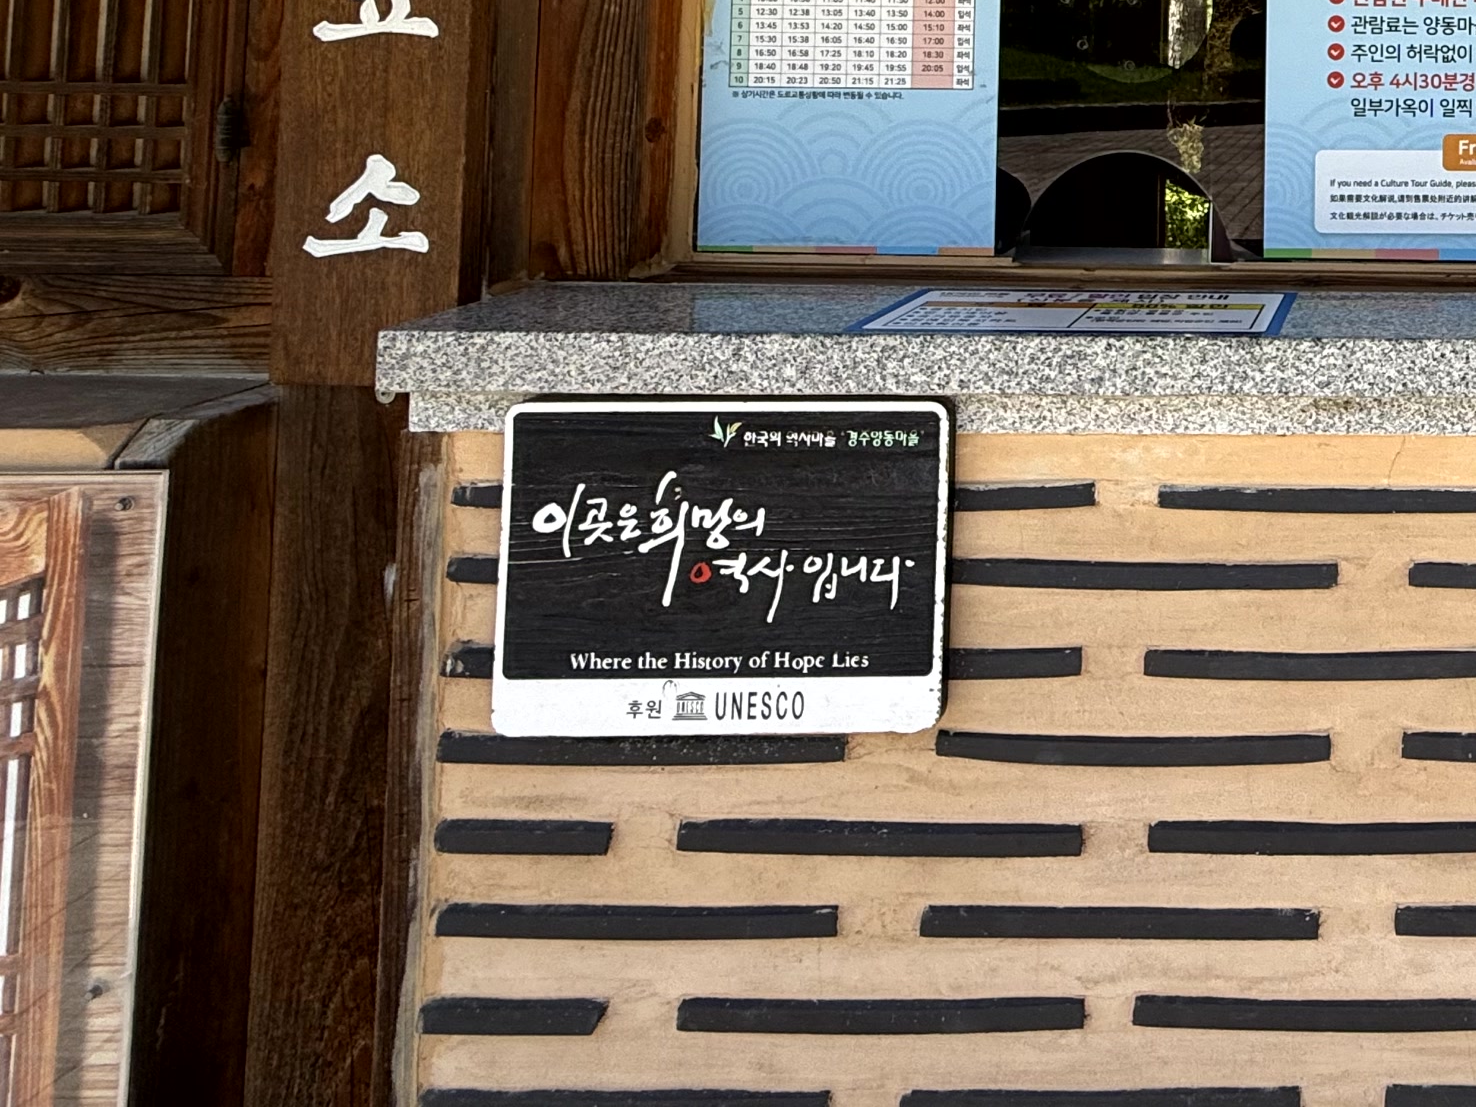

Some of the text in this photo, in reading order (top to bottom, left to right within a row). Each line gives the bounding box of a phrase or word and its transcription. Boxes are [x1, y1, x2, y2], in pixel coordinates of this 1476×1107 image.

[1329, 177, 1336, 187] If
[1336, 179, 1352, 189] you
[1352, 178, 1373, 188] need
[1379, 178, 1409, 188] Culture
[1409, 178, 1428, 188] Tour
[1429, 178, 1454, 189] Guide,
[570, 652, 631, 669] Where
[638, 652, 667, 668] the
[674, 651, 742, 673] History
[748, 651, 769, 667] of
[832, 652, 868, 667] Lies
[626, 700, 662, 719] 후원
[715, 691, 804, 720] UNESCO
